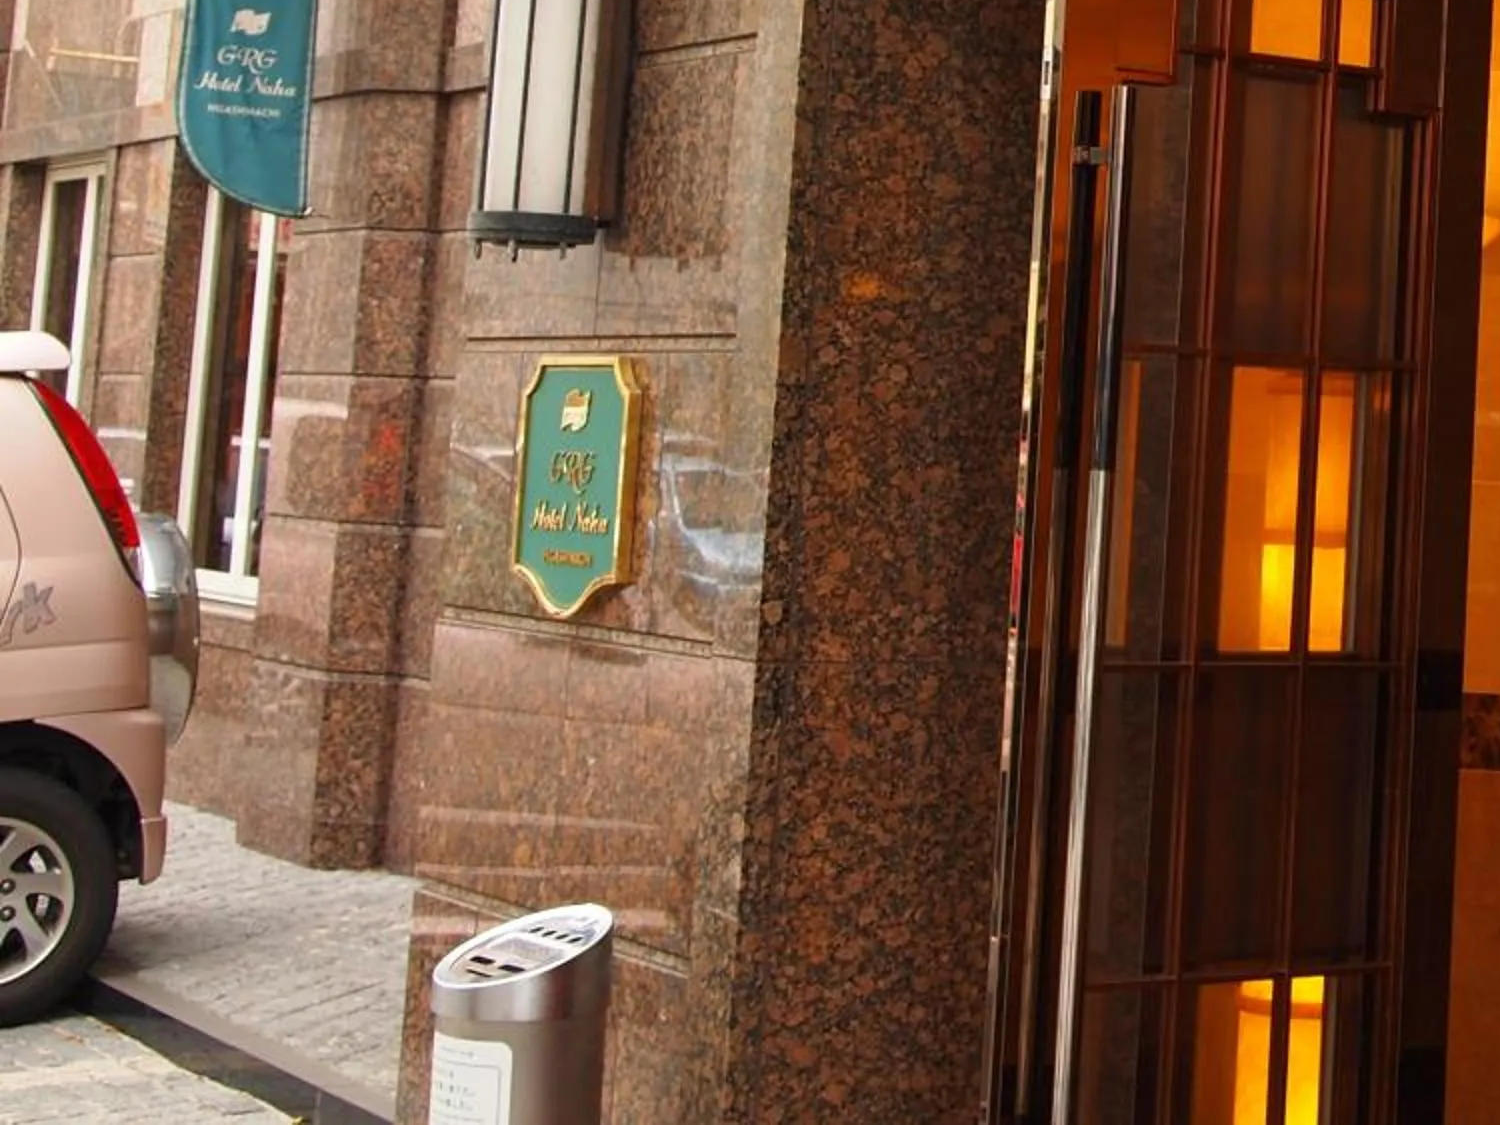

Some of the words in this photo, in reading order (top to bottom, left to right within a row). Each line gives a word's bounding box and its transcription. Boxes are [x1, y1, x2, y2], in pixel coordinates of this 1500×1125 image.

[216, 45, 279, 75] GRG
[193, 70, 243, 93] Hotel
[244, 75, 297, 98] Naha
